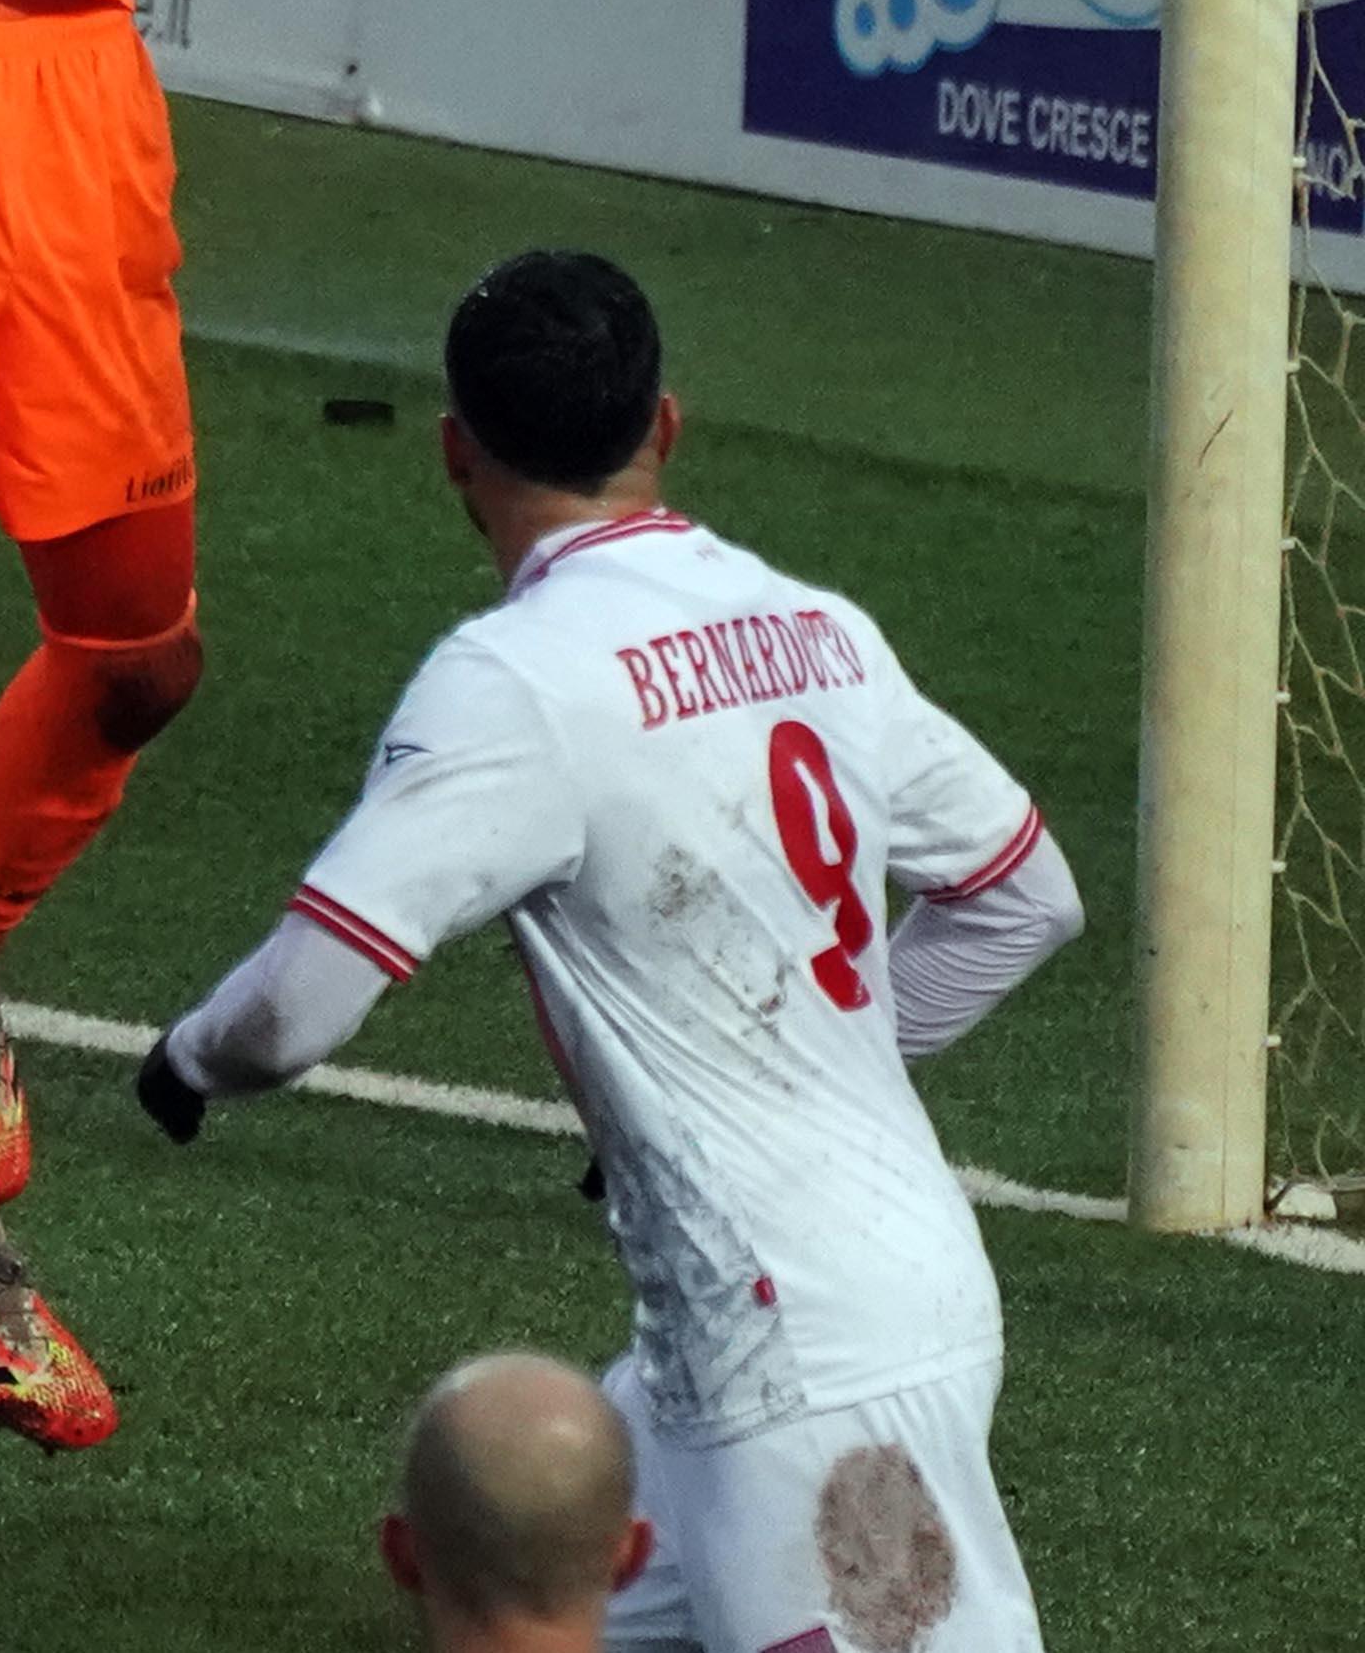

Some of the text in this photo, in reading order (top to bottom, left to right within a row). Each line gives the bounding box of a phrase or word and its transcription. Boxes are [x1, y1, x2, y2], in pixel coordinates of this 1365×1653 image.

[937, 81, 1020, 146] DOVE
[1027, 95, 1153, 169] CRESCE
[768, 719, 873, 1013] 9
